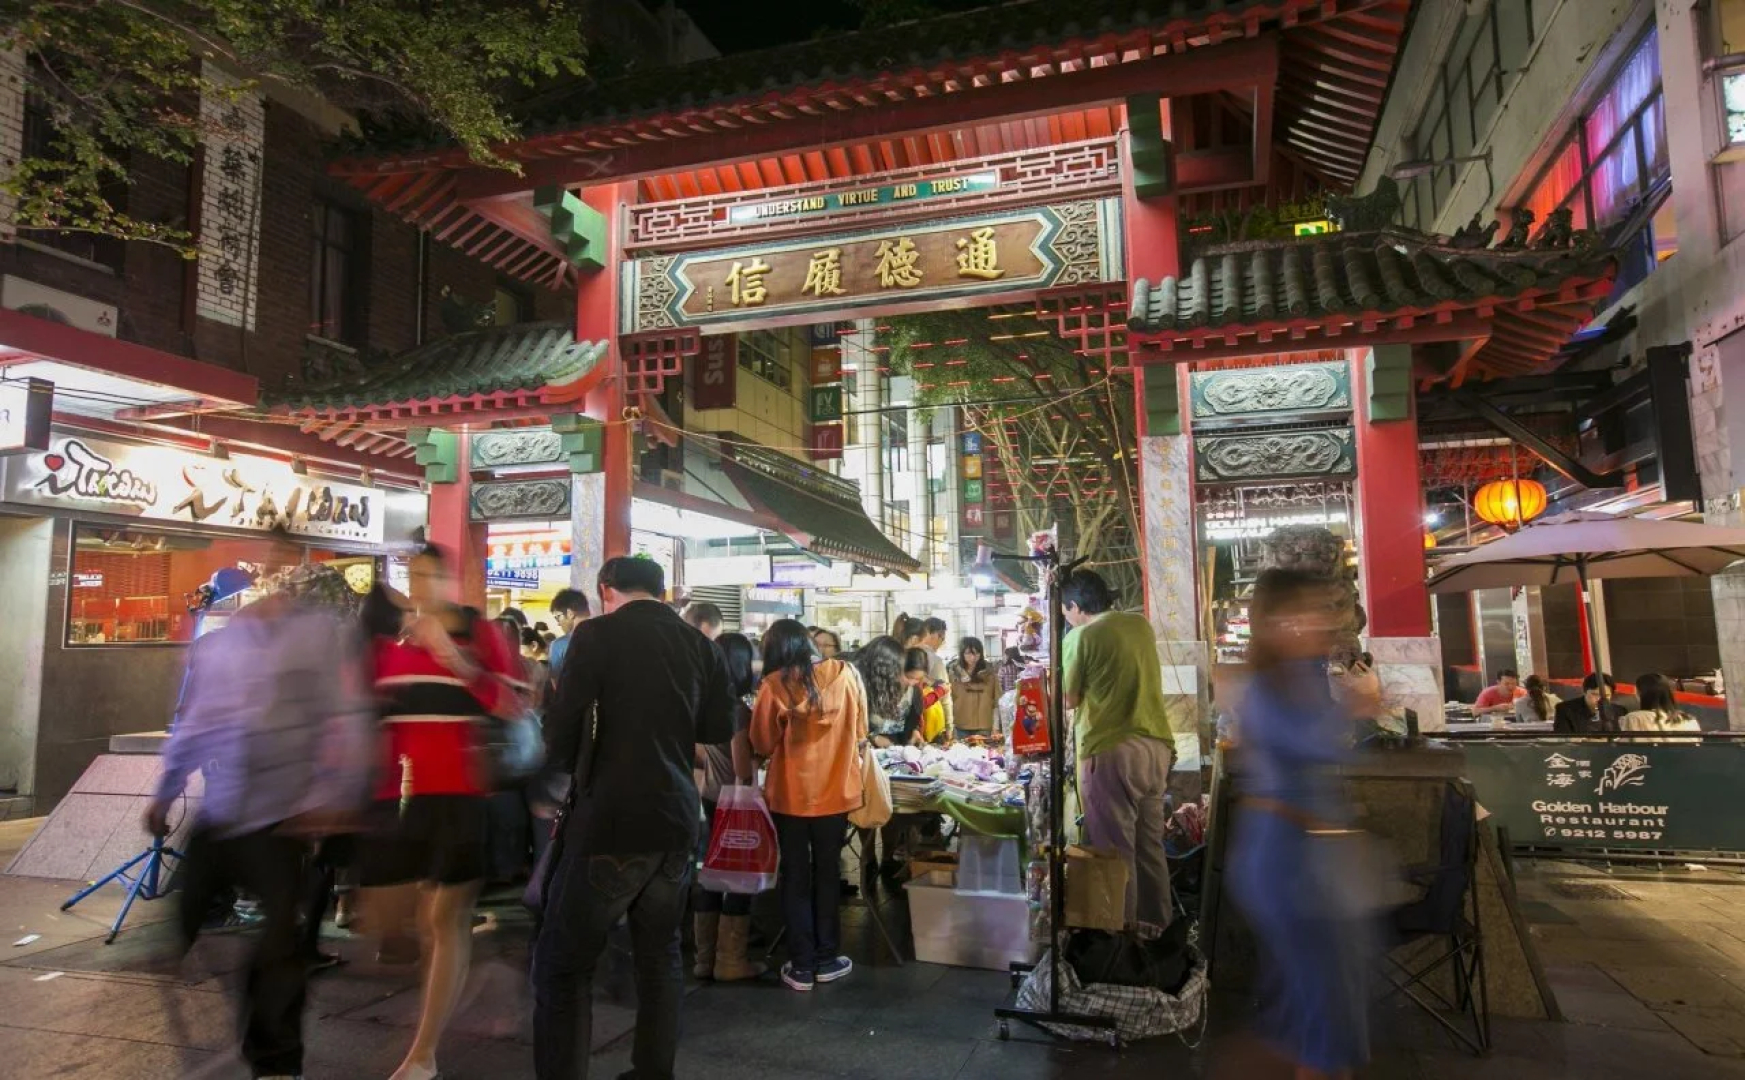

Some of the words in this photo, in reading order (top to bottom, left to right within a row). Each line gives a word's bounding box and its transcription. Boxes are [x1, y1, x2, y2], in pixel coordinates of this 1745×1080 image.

[755, 197, 825, 218] UNDERSTAND
[837, 188, 878, 206] VIRTUE
[893, 183, 917, 199] AND
[930, 178, 969, 194] TRUST
[1531, 800, 1592, 814] Golden
[1598, 801, 1669, 815] Harbour
[1540, 814, 1666, 828] Restaurant
[1560, 828, 1607, 839] 9212
[1613, 830, 1663, 840] 5987
